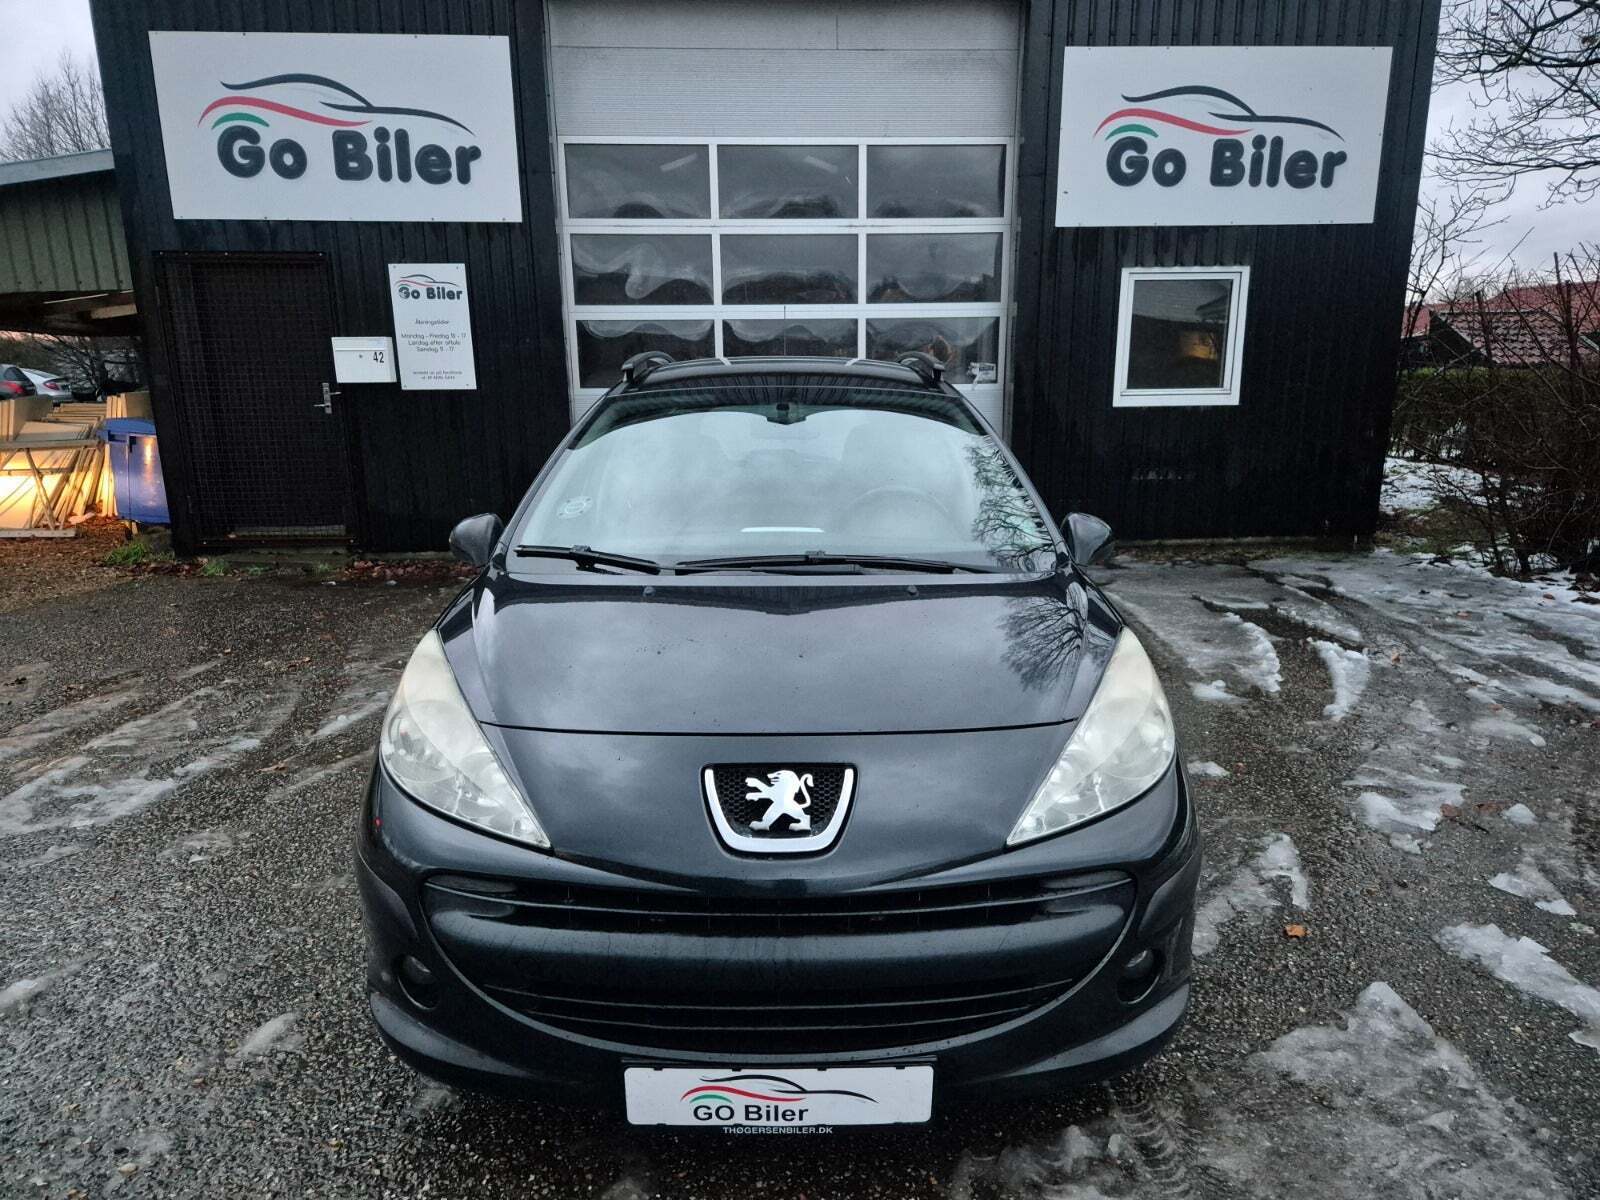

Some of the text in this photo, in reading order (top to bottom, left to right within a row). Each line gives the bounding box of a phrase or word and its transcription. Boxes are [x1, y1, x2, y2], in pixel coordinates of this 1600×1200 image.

[217, 125, 482, 185] Go Biler
[1106, 134, 1347, 189] Go Biler
[399, 286, 463, 300] Go Biler
[373, 352, 385, 364] 42
[693, 1104, 809, 1122] GO Biler
[722, 1126, 833, 1134] THØGERSENBILER.DK
